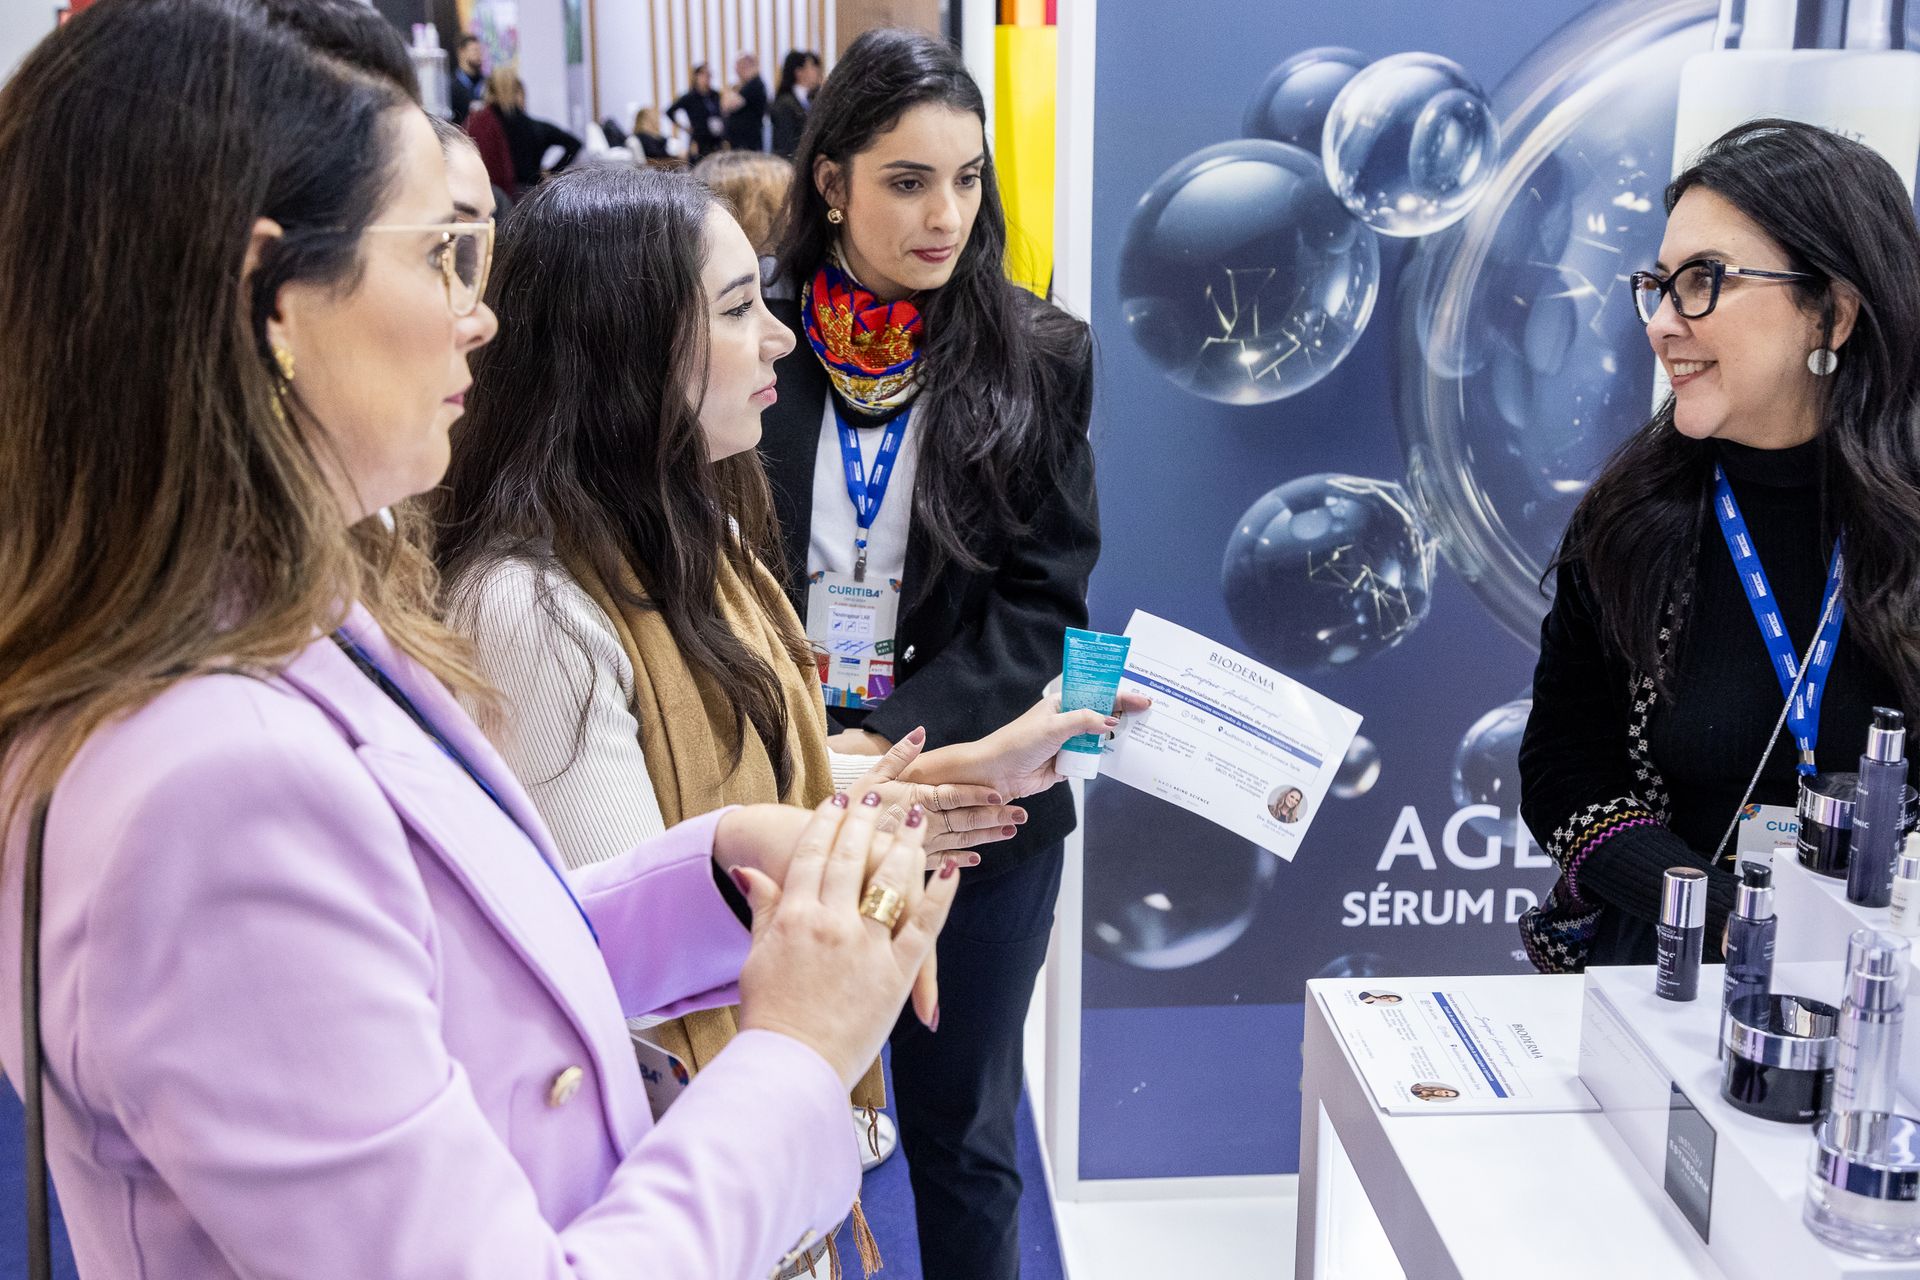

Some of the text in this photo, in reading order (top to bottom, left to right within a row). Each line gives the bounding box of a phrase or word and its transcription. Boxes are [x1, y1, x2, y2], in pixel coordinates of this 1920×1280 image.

[1208, 651, 1277, 692] BIODERMA
[1341, 882, 1495, 927] SÉRUM
[1512, 1023, 1543, 1059] BIODERMA
[1669, 1139, 1709, 1193] ESTHEDERM
